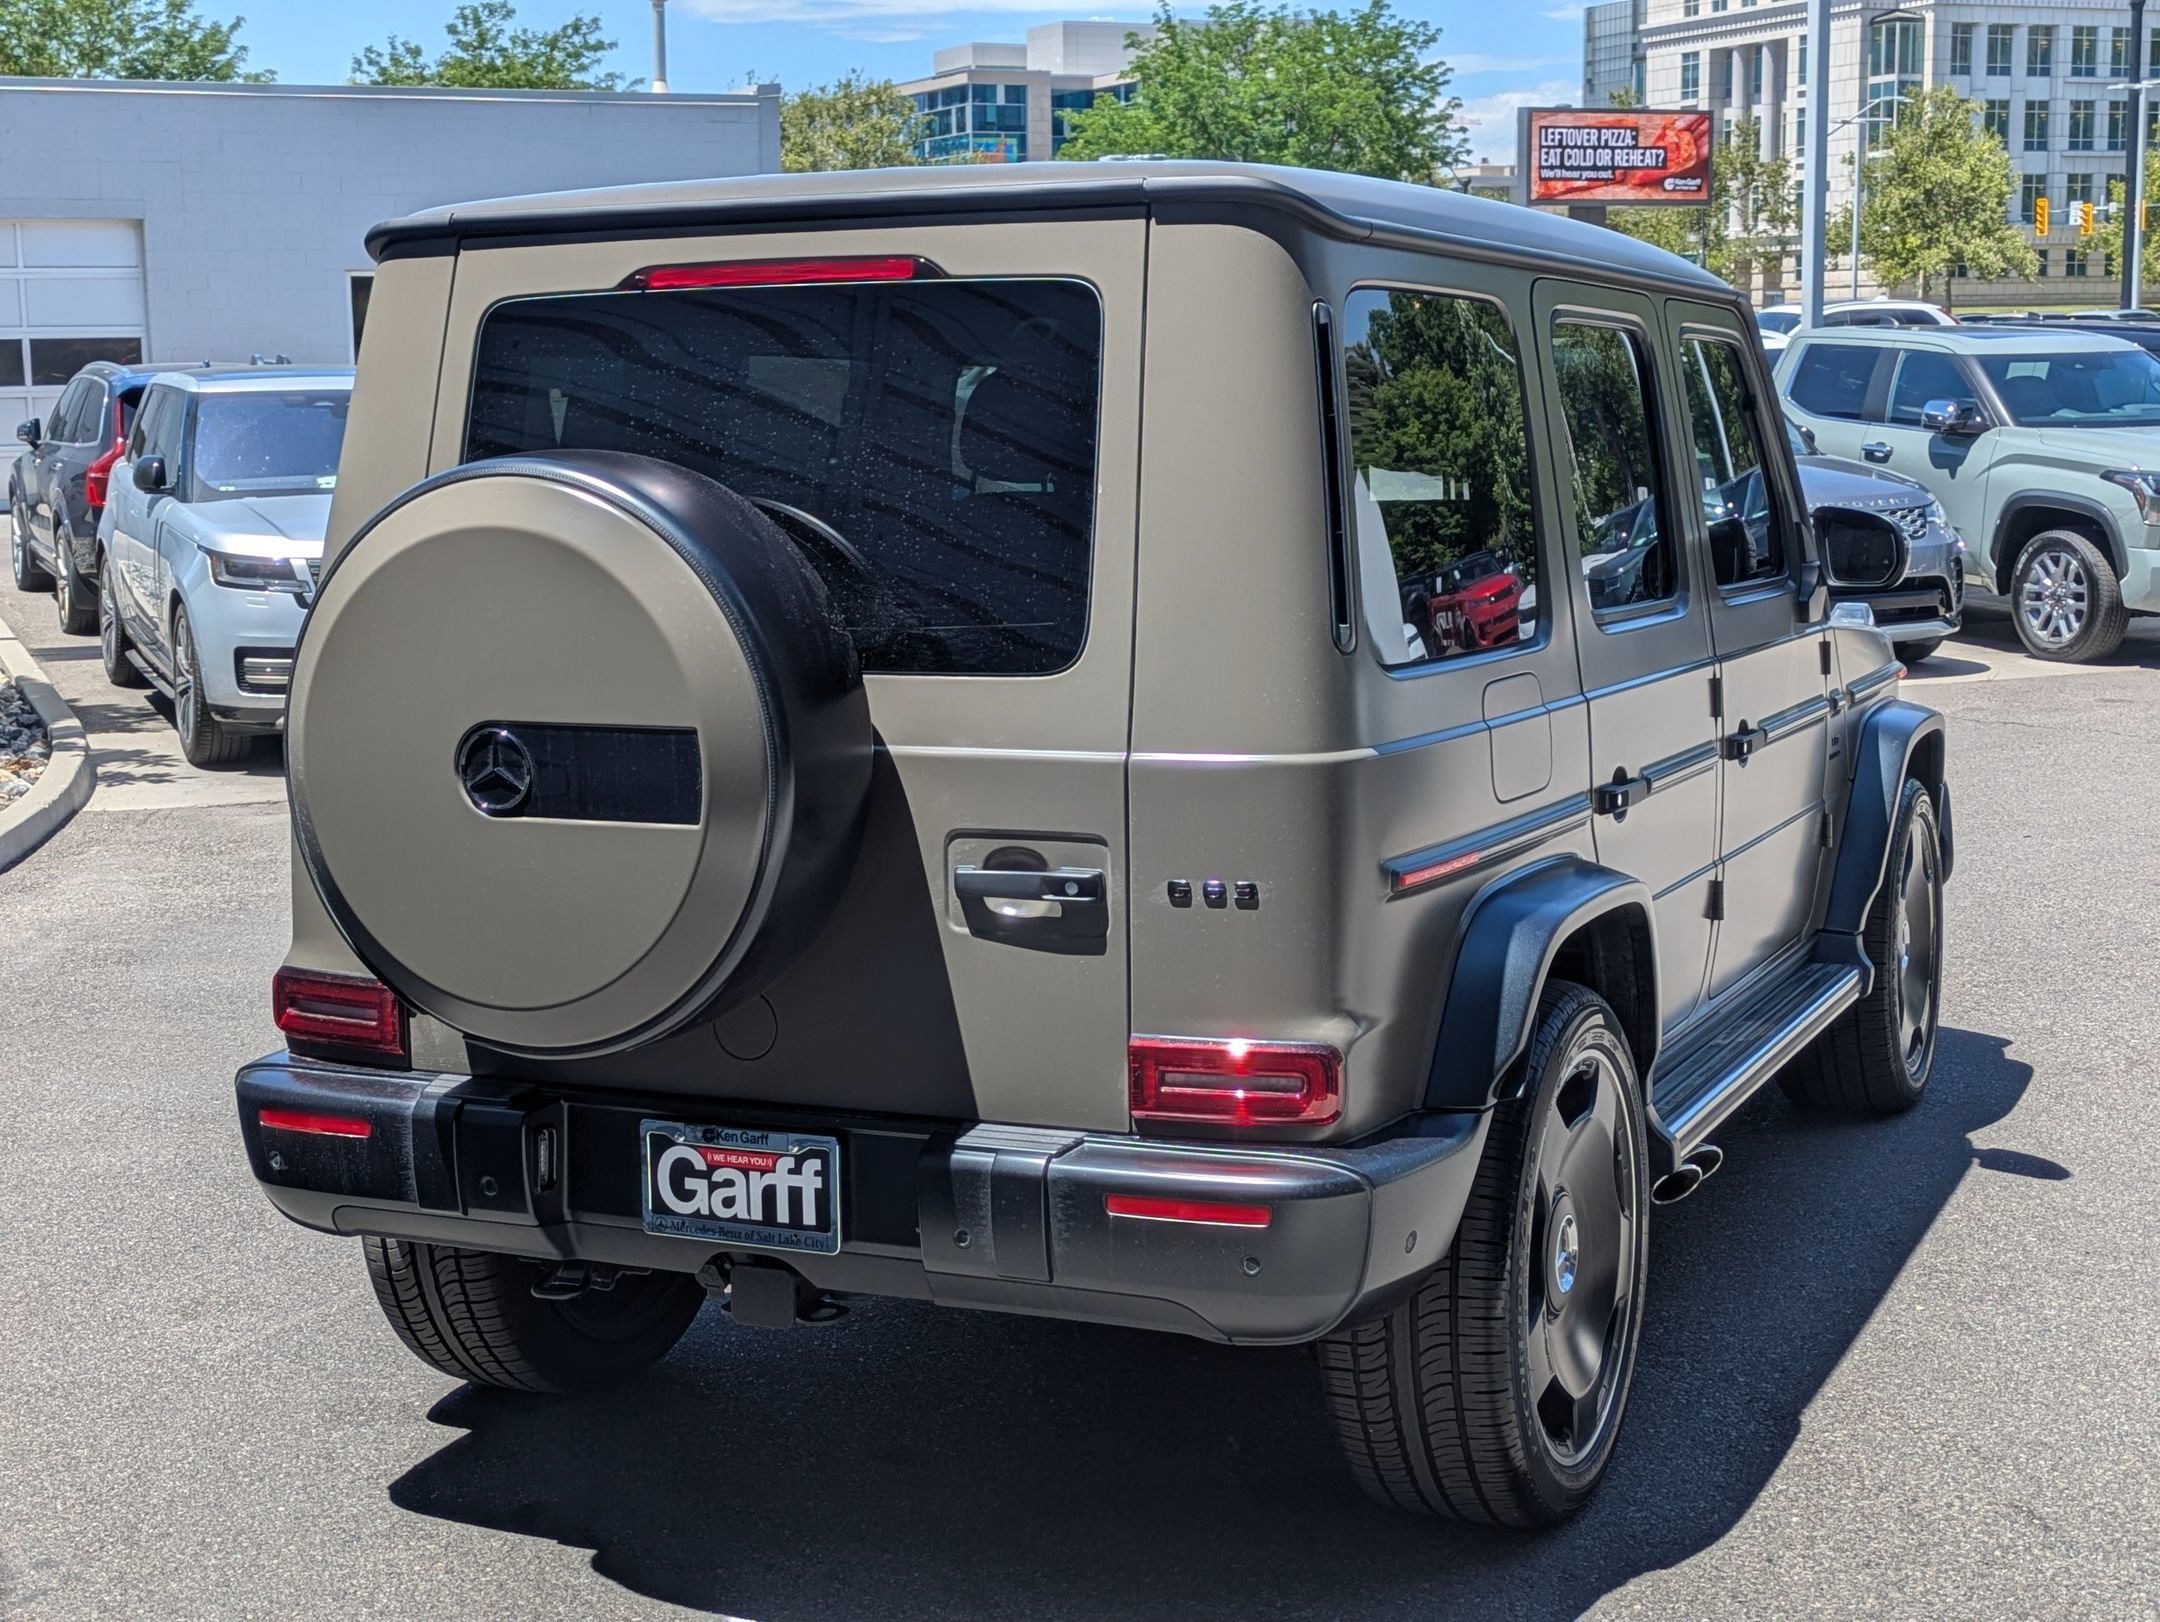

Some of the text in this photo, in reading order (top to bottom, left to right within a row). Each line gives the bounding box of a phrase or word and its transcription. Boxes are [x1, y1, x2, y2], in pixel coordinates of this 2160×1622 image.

[1541, 128, 1637, 147] LEFTOVER PIZZA:
[1541, 148, 1665, 167] EAT COLD OR REHEAT?
[1541, 169, 1614, 180] We'll hear you out.
[716, 1129, 738, 1142] Ken
[740, 1131, 769, 1146] Garff
[713, 1153, 767, 1166] WE HEAR YOU
[657, 1145, 822, 1226] Garff
[744, 1230, 755, 1242] of
[756, 1231, 775, 1245] Salt
[778, 1233, 801, 1247] Lake
[804, 1235, 826, 1249] City
